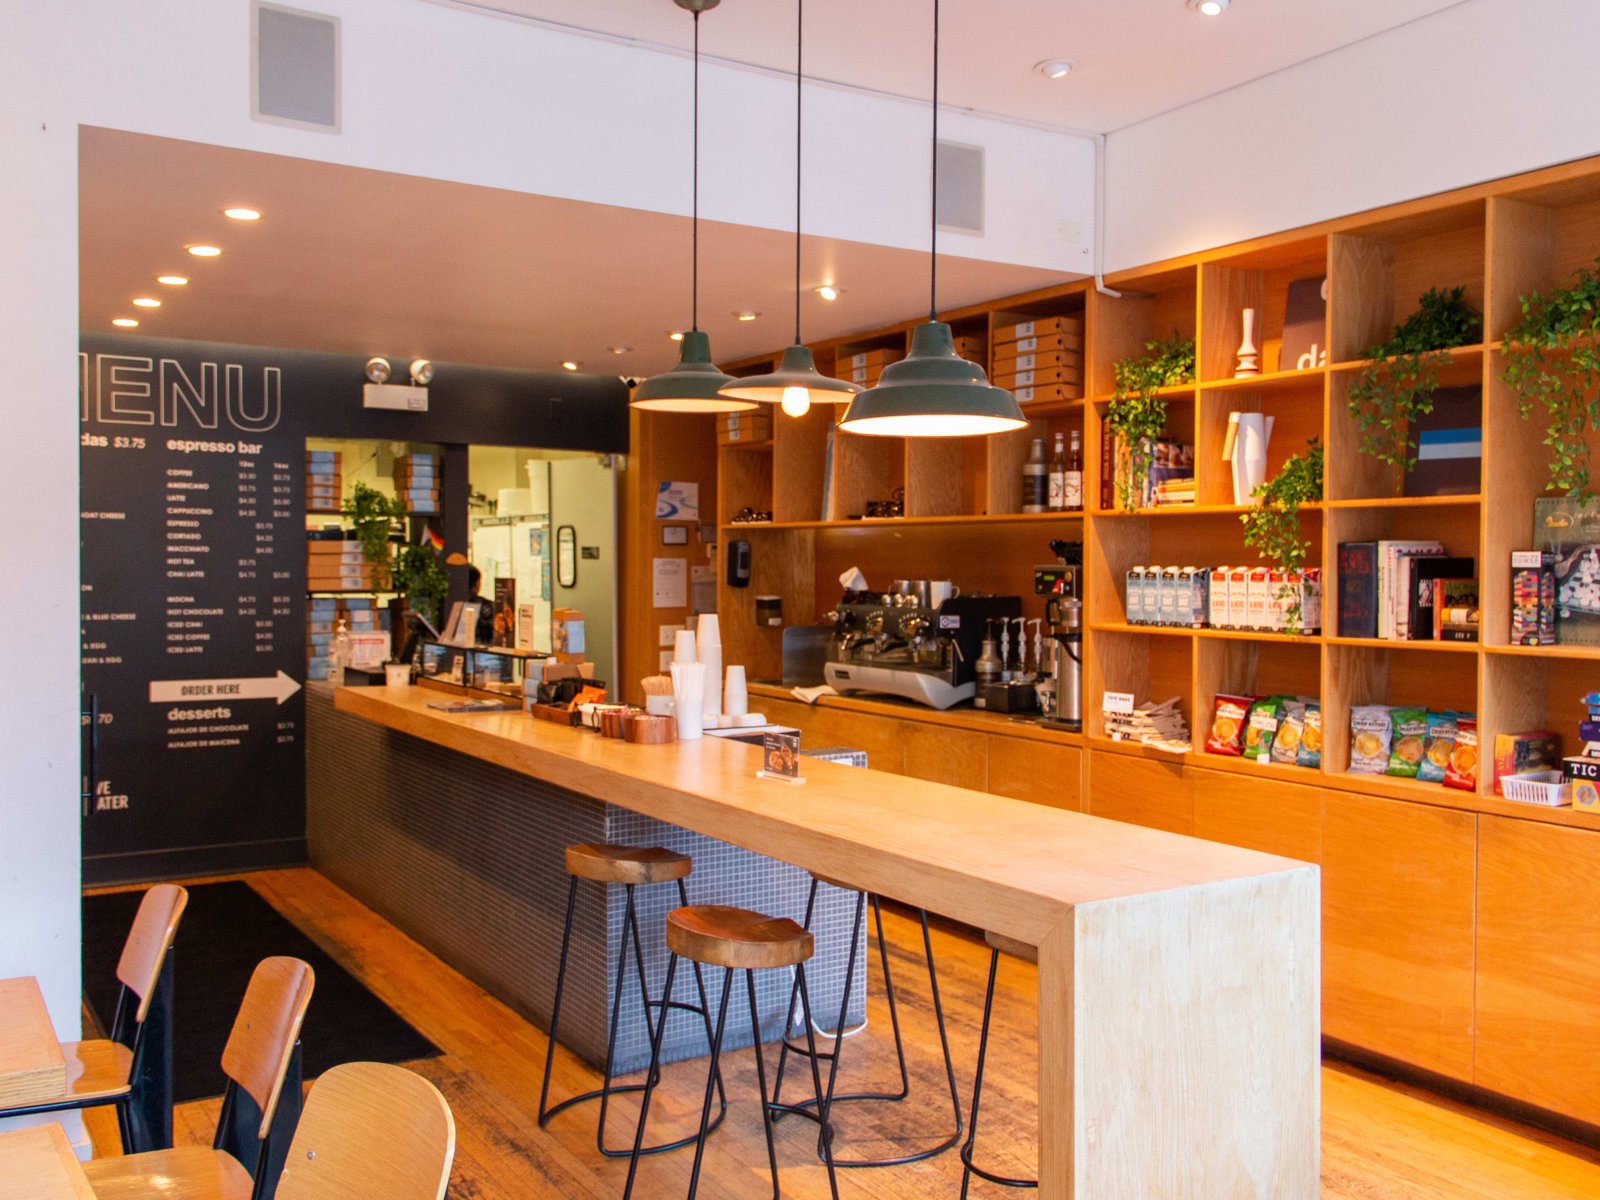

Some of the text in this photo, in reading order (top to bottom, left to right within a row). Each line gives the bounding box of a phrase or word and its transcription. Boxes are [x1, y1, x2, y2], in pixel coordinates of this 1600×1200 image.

[80, 352, 281, 432] ENU
[113, 437, 146, 449] $3.75
[167, 438, 262, 454] espresso bar
[167, 469, 193, 477] COFFEE
[167, 482, 209, 490] AMERICANO
[167, 507, 213, 516] CAPPUCCINO
[100, 512, 126, 520] CHEESE
[167, 520, 200, 528] ESPRESSO
[167, 533, 202, 541] CORTADO
[167, 545, 210, 553] MACCHIATO
[167, 570, 185, 578] CHAI
[186, 570, 205, 578] LATTE
[167, 608, 181, 616] HOT
[183, 608, 224, 616] CHOCOLATE
[110, 613, 136, 621] CHEESE
[167, 621, 184, 629] ICED
[185, 633, 210, 641] COFFEE
[167, 646, 184, 654] ICED
[182, 684, 240, 696] ORDER HERE
[168, 707, 231, 721] desserts
[168, 726, 197, 735] ALFAJOR
[199, 725, 207, 733] DE
[209, 724, 249, 733] CHOCOLATE
[168, 740, 197, 749] ALFAJOR
[199, 739, 207, 747] DE
[209, 738, 240, 747] MAICENA
[1571, 763, 1597, 777] TIC
